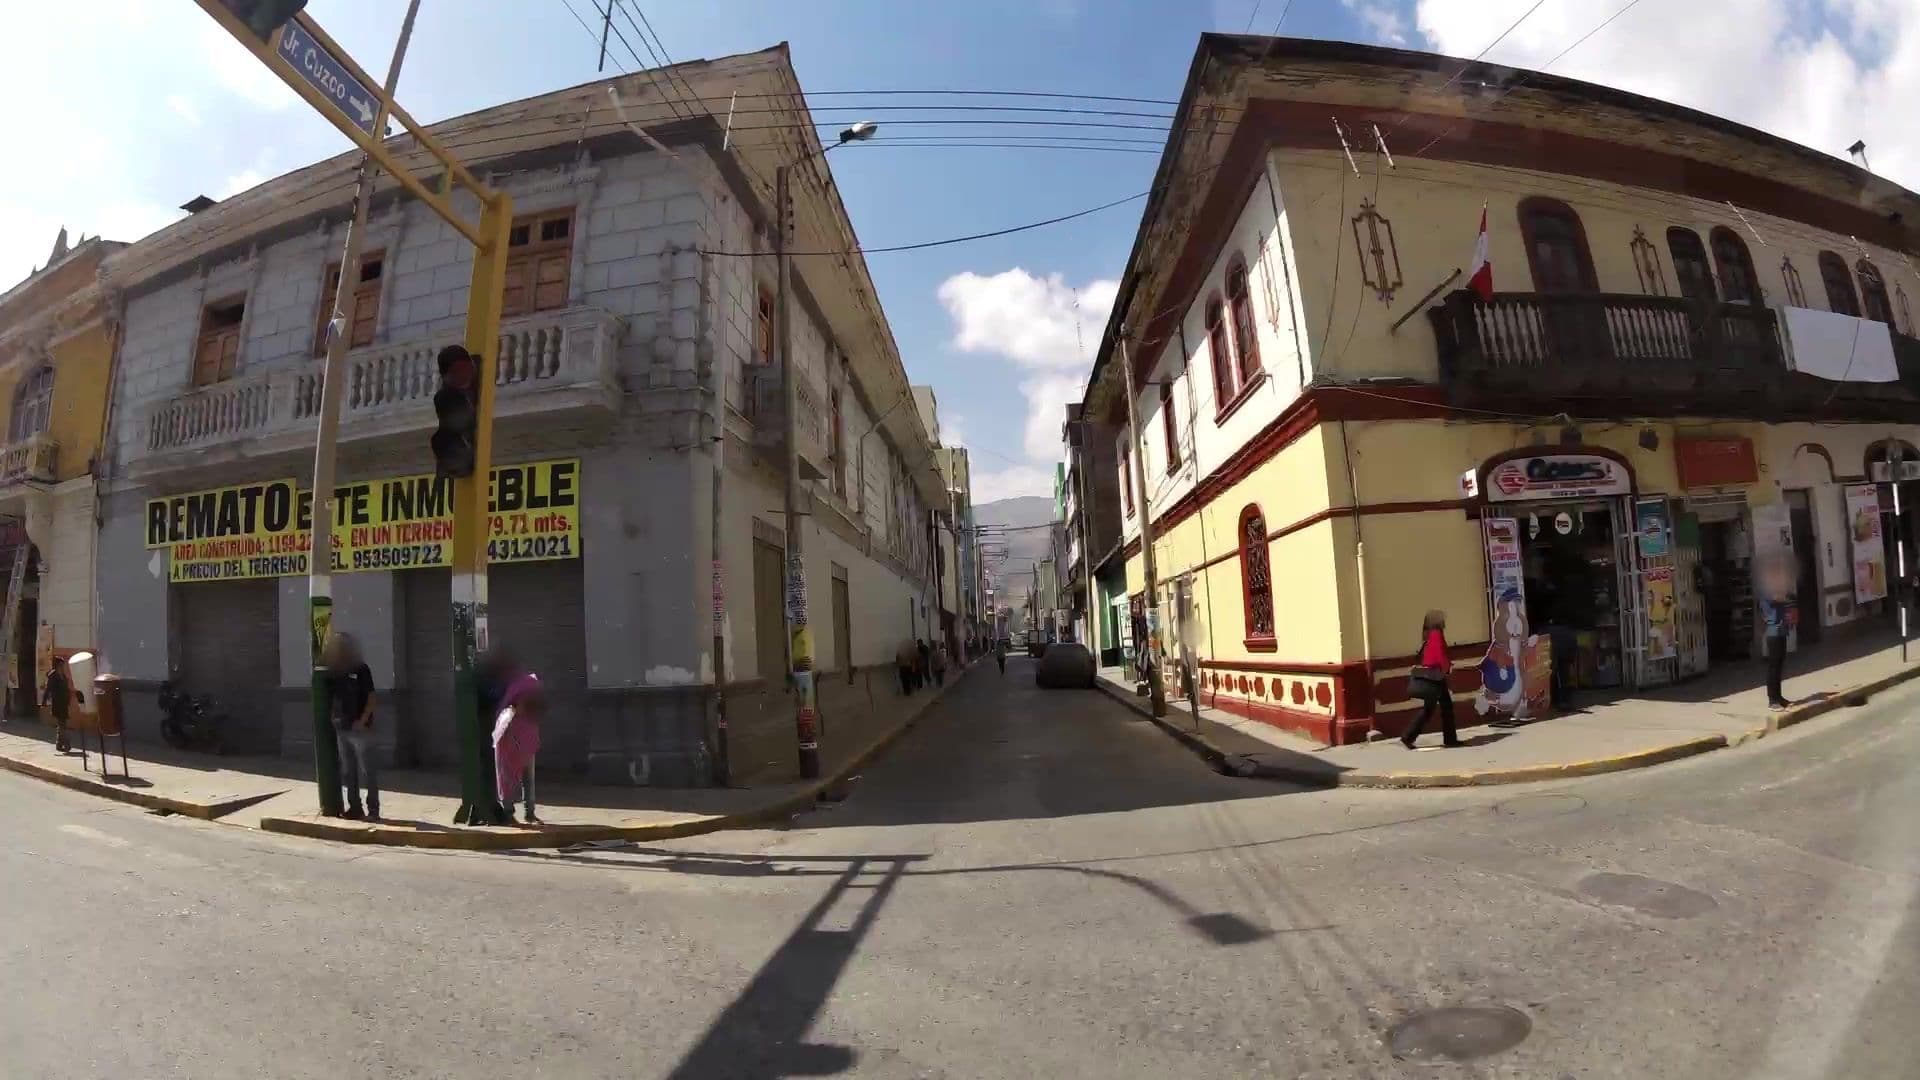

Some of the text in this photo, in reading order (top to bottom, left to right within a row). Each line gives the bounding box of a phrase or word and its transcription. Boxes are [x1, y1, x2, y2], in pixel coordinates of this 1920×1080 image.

[283, 29, 346, 99] Jr. Cuzco
[148, 463, 575, 545] REMATO ETE INMBLE
[351, 527, 368, 547] EN
[373, 523, 391, 545] UN
[397, 519, 453, 543] TERREN
[535, 512, 572, 533] mts.
[173, 563, 181, 580] A
[183, 561, 221, 579] PRECIO
[224, 559, 244, 577] DEL
[249, 554, 307, 576] TERRENO
[331, 551, 349, 570] EL.
[353, 543, 442, 569] 953509722
